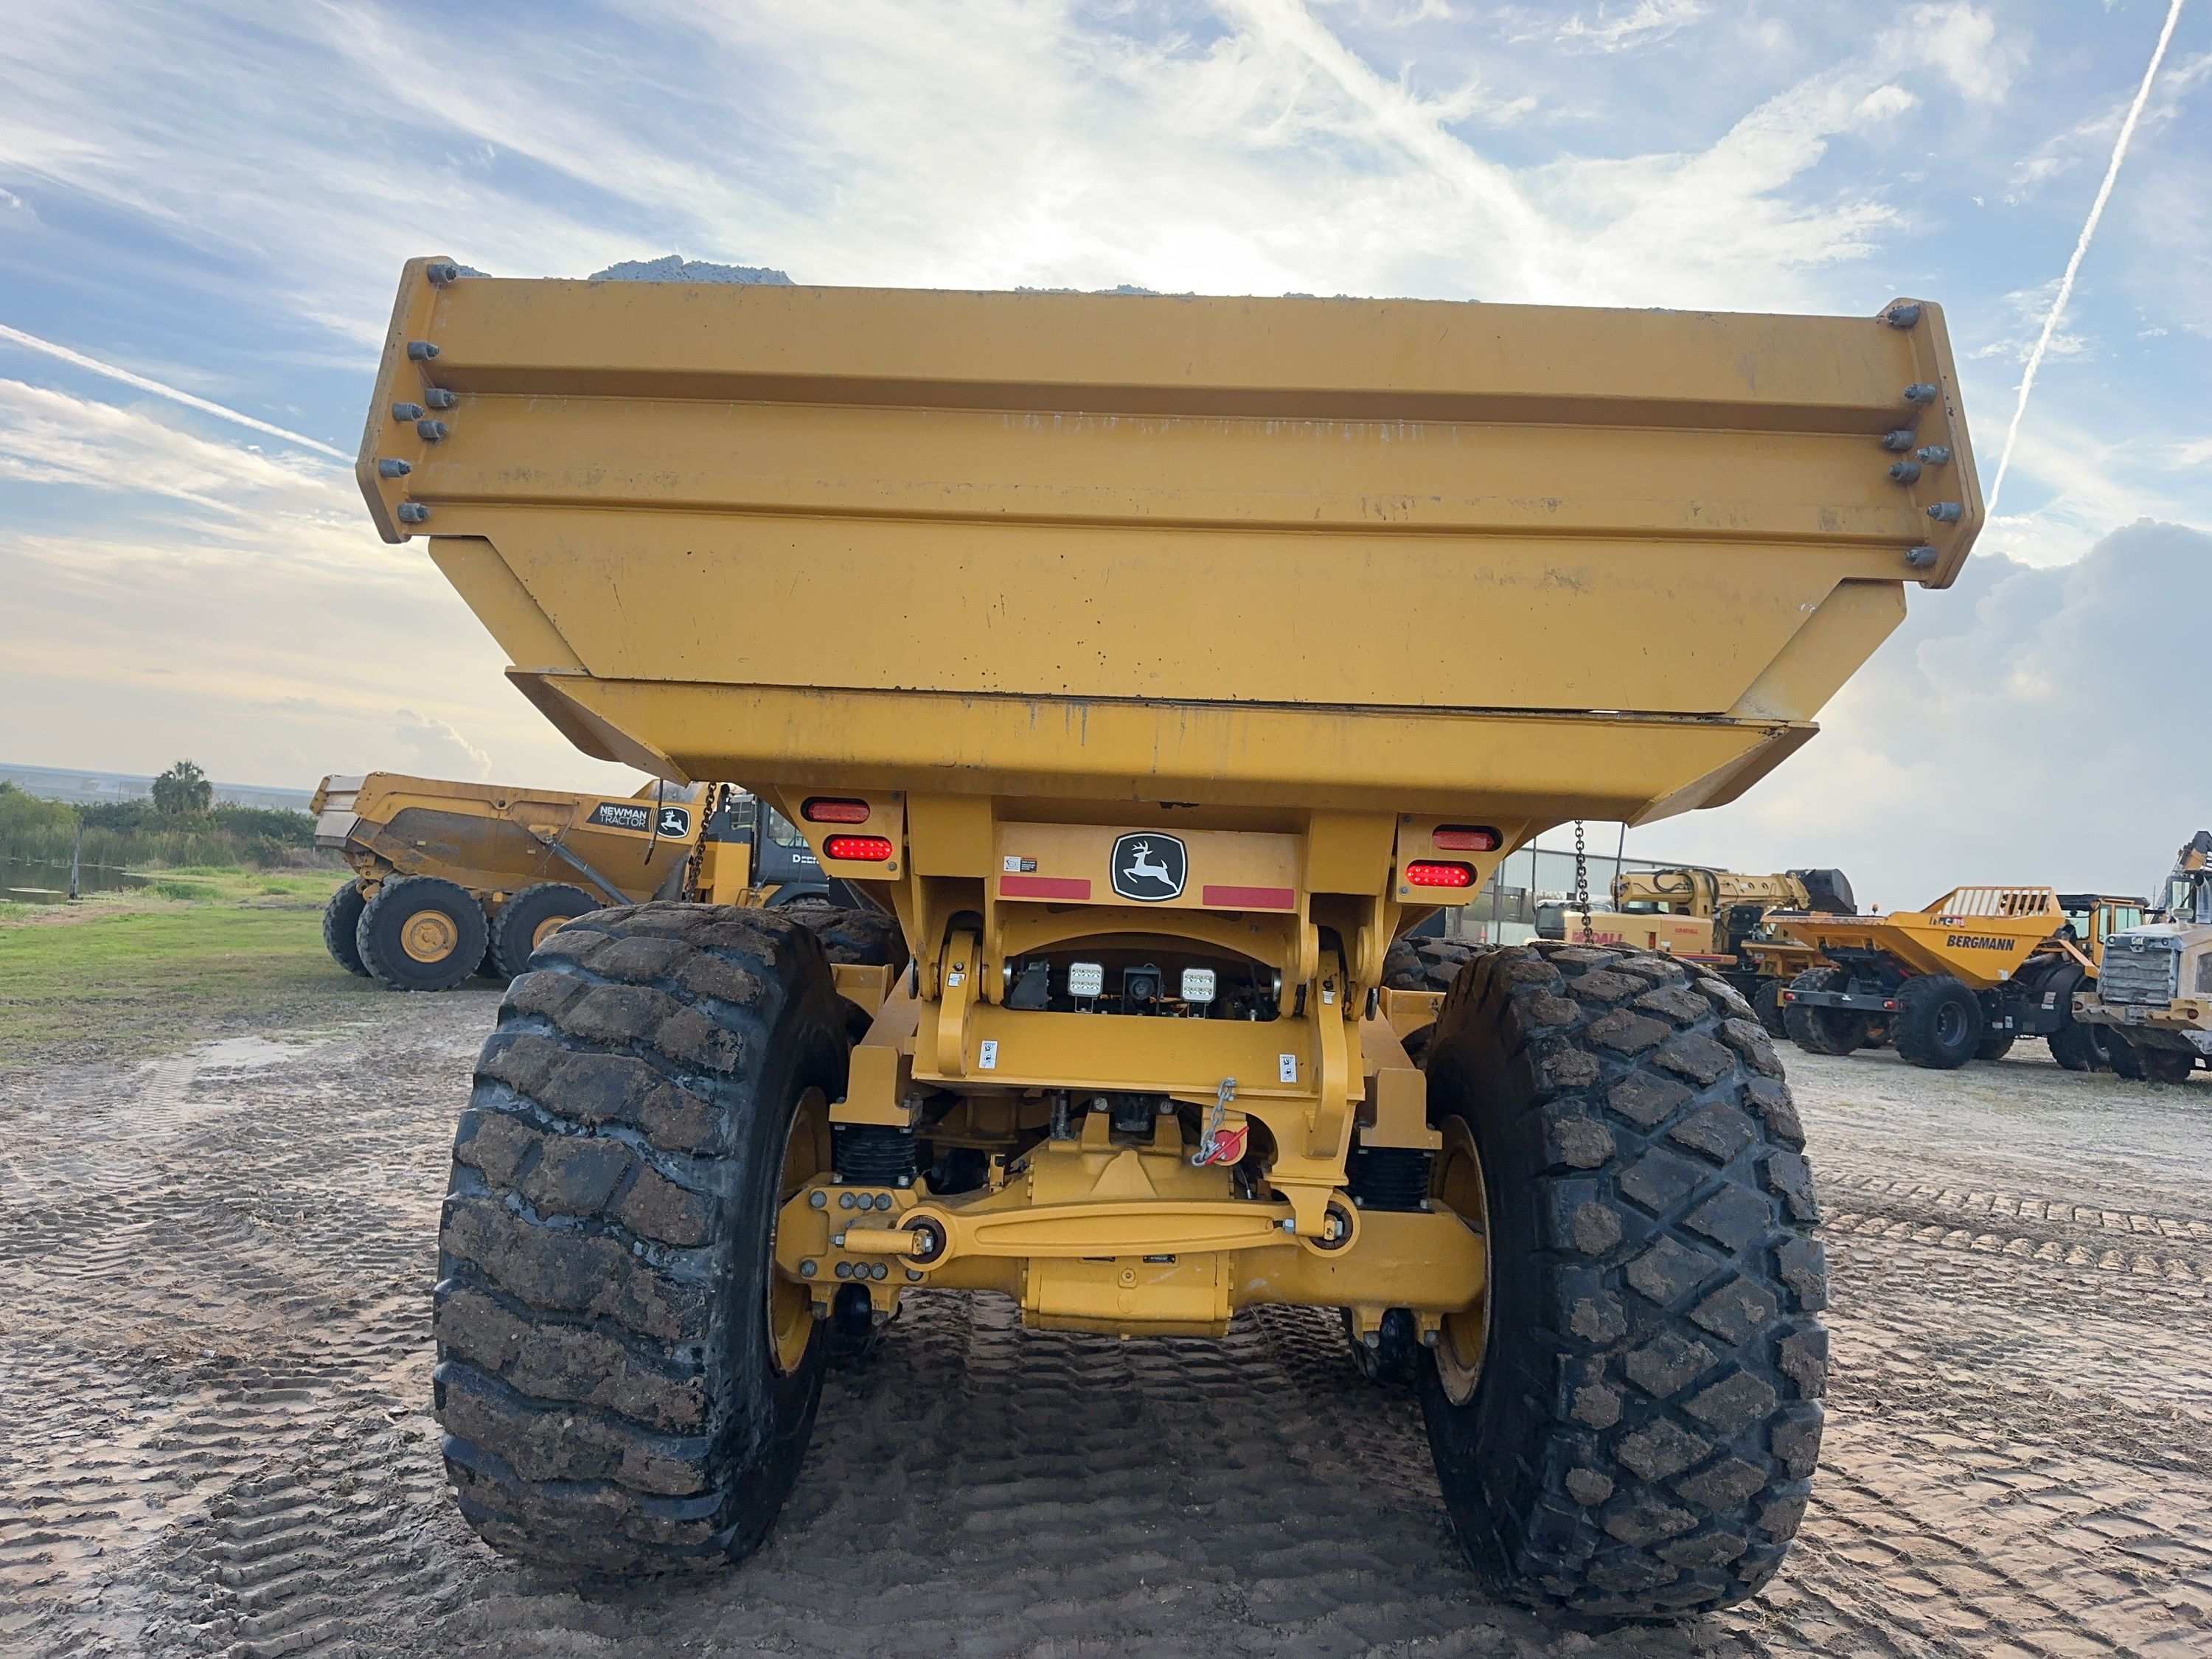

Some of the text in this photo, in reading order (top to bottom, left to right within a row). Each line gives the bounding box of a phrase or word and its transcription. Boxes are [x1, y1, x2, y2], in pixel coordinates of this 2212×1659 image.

[599, 805, 647, 819] NEWMAN
[599, 814, 646, 827] TRACTOR
[793, 854, 819, 864] DEER
[1571, 931, 1623, 944] GRDAL
[1947, 934, 2015, 951] BERGMANN
